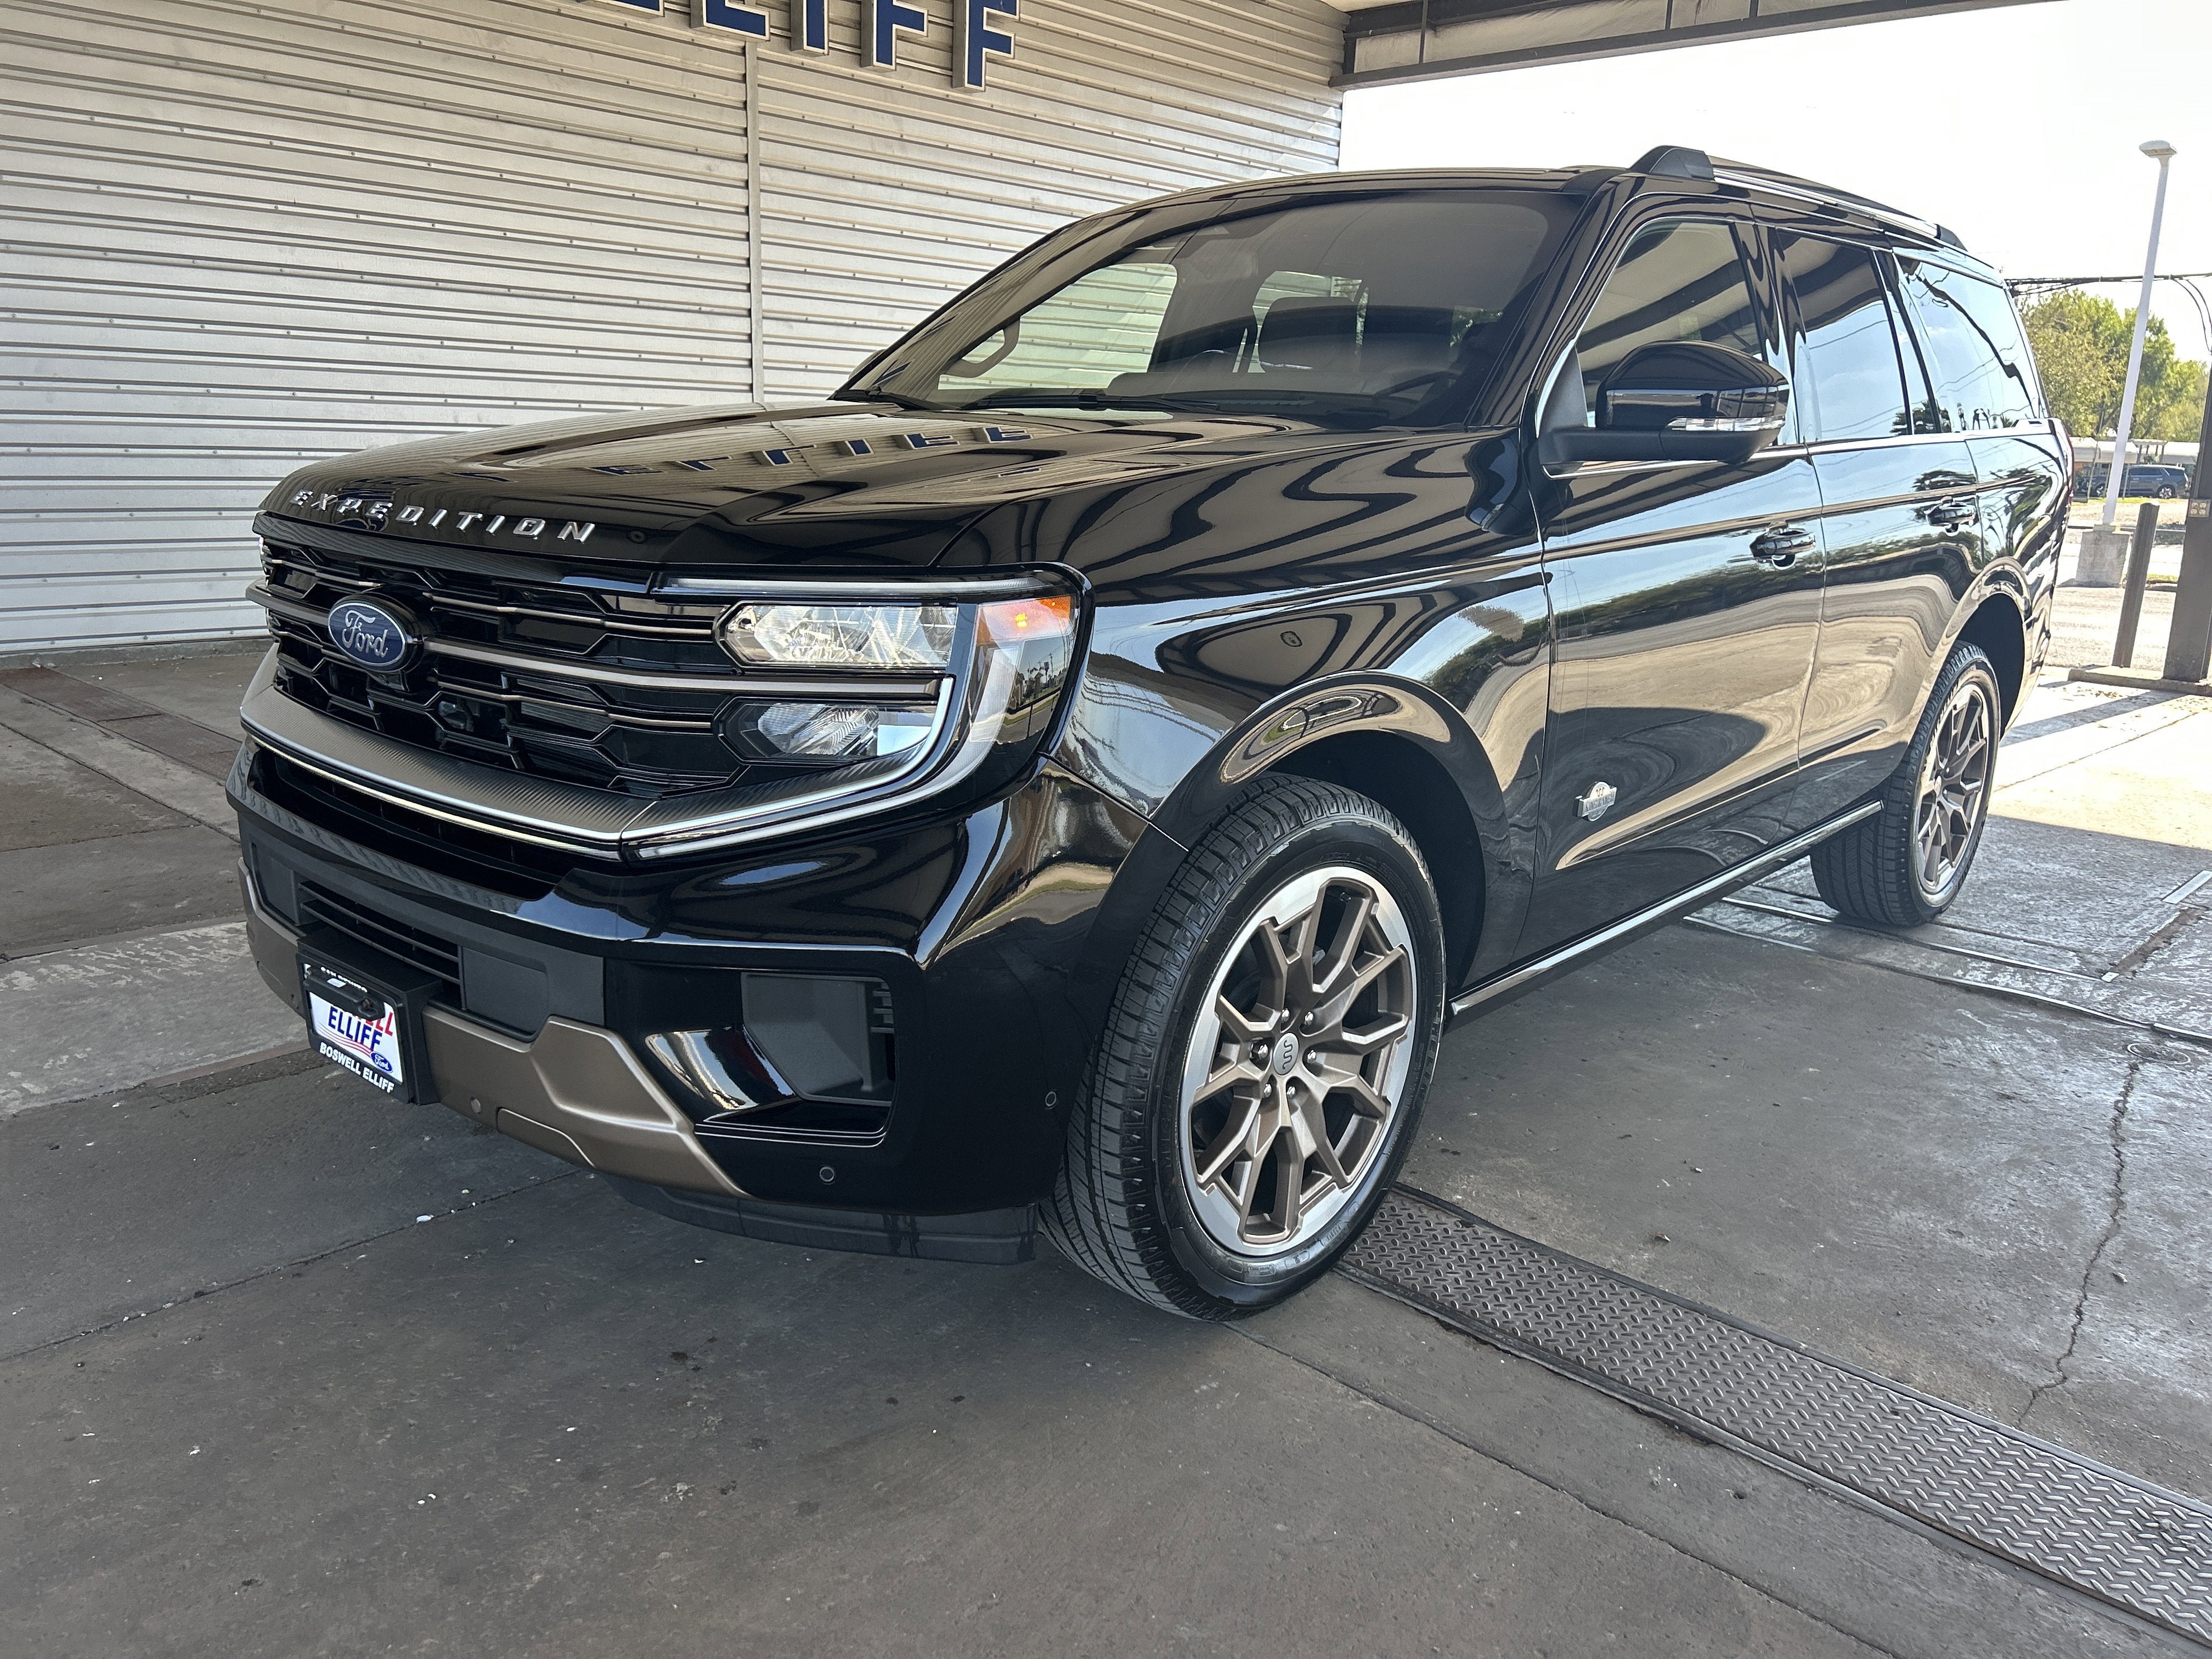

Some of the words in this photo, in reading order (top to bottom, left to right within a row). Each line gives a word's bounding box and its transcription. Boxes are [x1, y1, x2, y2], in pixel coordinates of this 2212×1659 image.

[289, 489, 596, 543] EXPEDITION
[342, 610, 389, 658] Ford
[328, 1006, 383, 1051] ELLIFF
[320, 1042, 361, 1076] BOSWELL
[362, 1066, 394, 1093] ELLIFF
[375, 1053, 390, 1070] Ford
